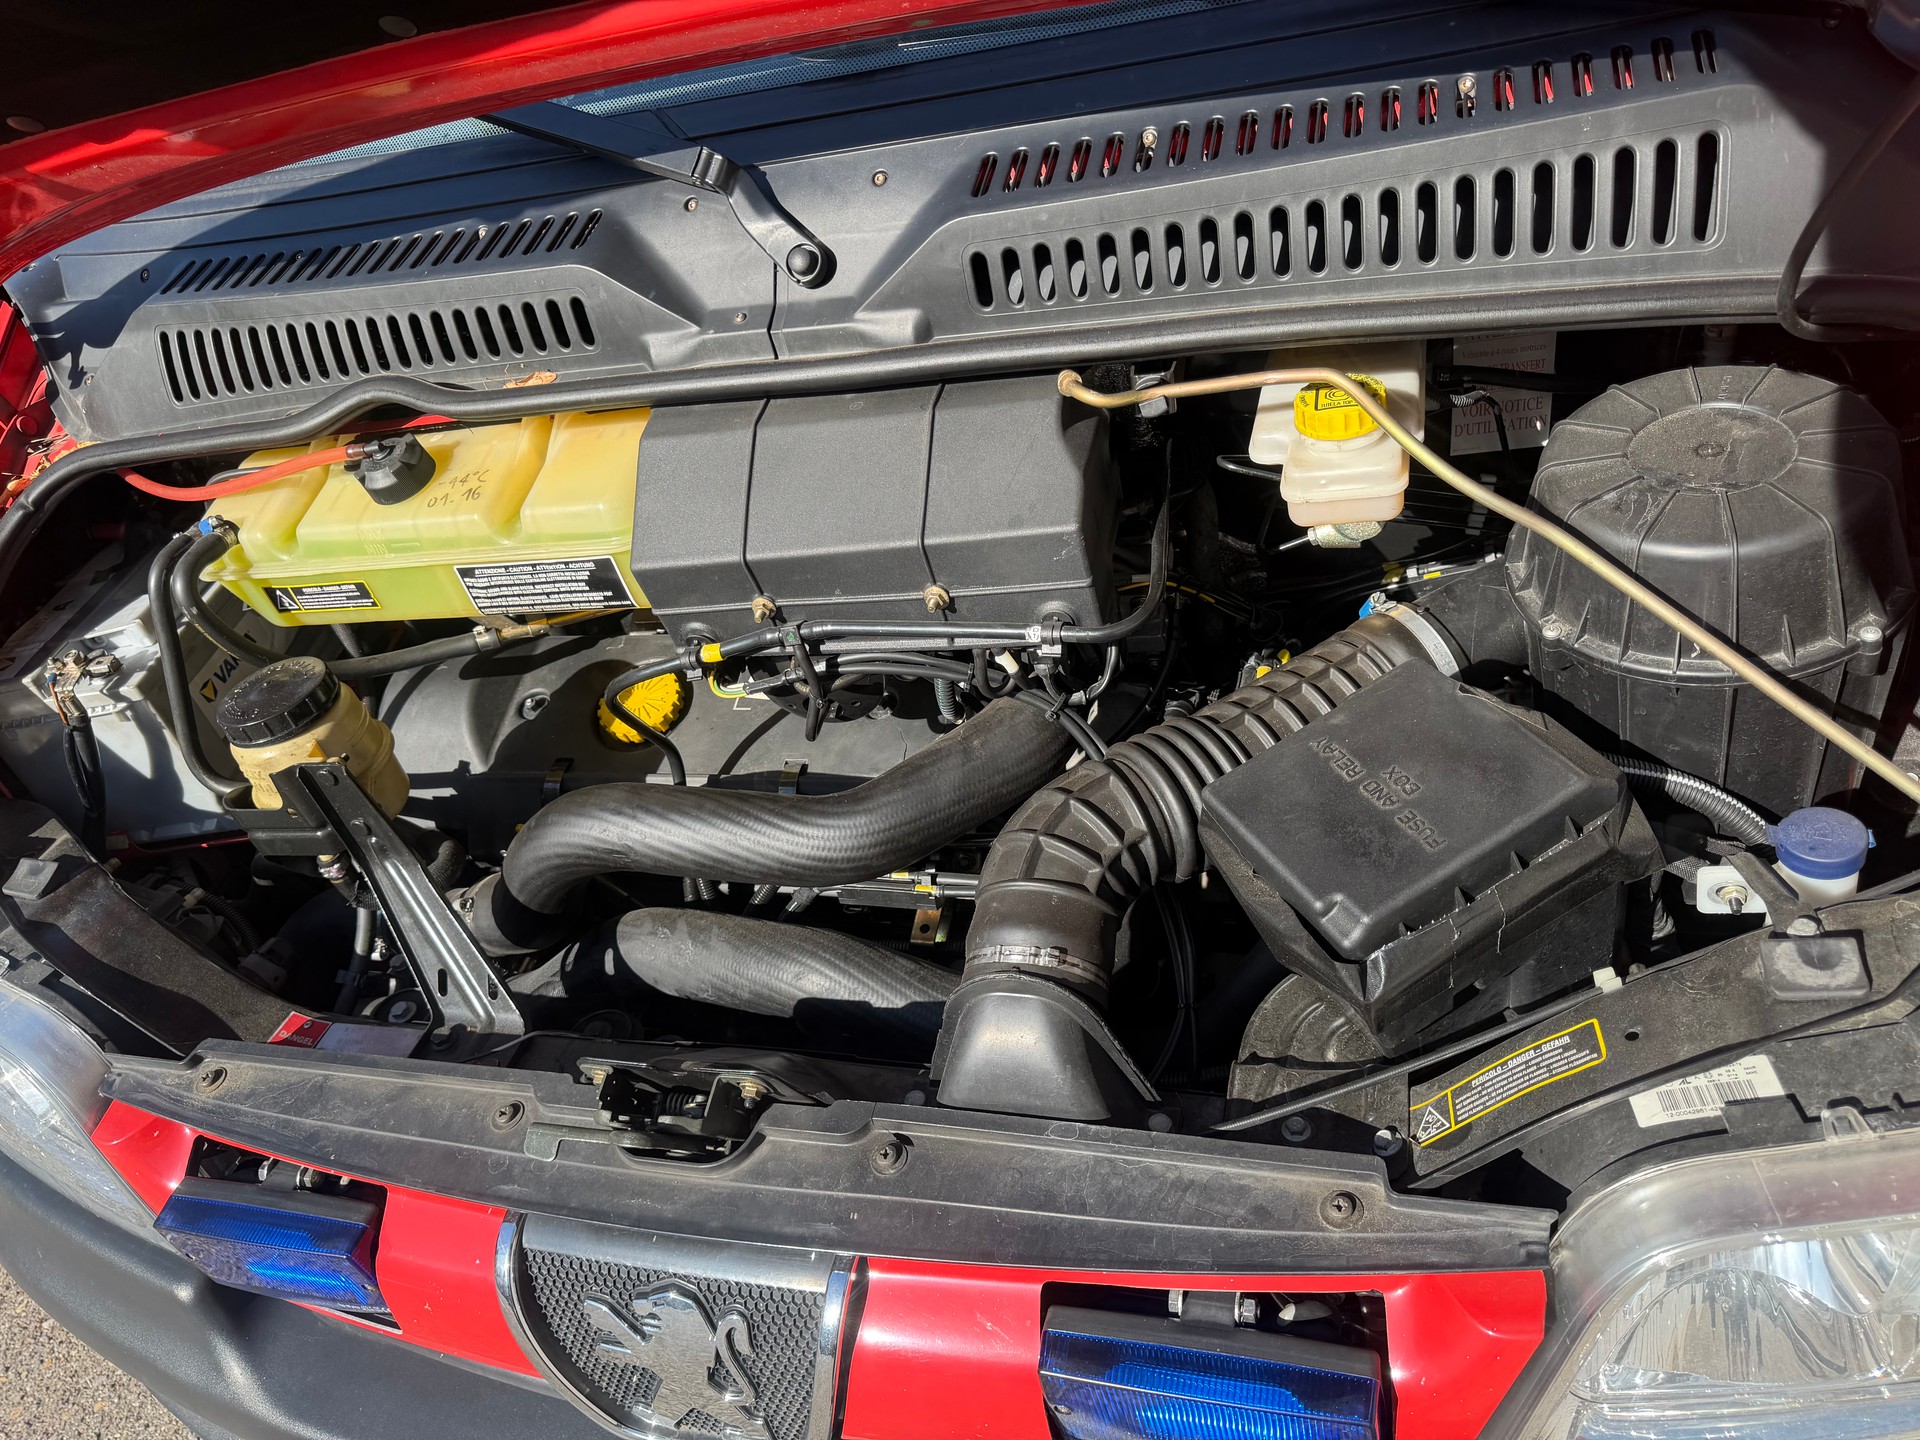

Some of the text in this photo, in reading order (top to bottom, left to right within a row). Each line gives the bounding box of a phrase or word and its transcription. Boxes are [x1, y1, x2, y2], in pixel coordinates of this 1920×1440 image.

[1461, 402, 1492, 418] VOIR
[1454, 414, 1548, 438] D'UTILATION
[1310, 736, 1447, 850] FUSE AND RELAY
[1381, 765, 1421, 797] BOX
[278, 1030, 313, 1046] DANGEL
[1471, 1067, 1502, 1087] PERICOLO
[1508, 1049, 1535, 1067] DANGER
[1541, 1035, 1570, 1051] GEFAHR
